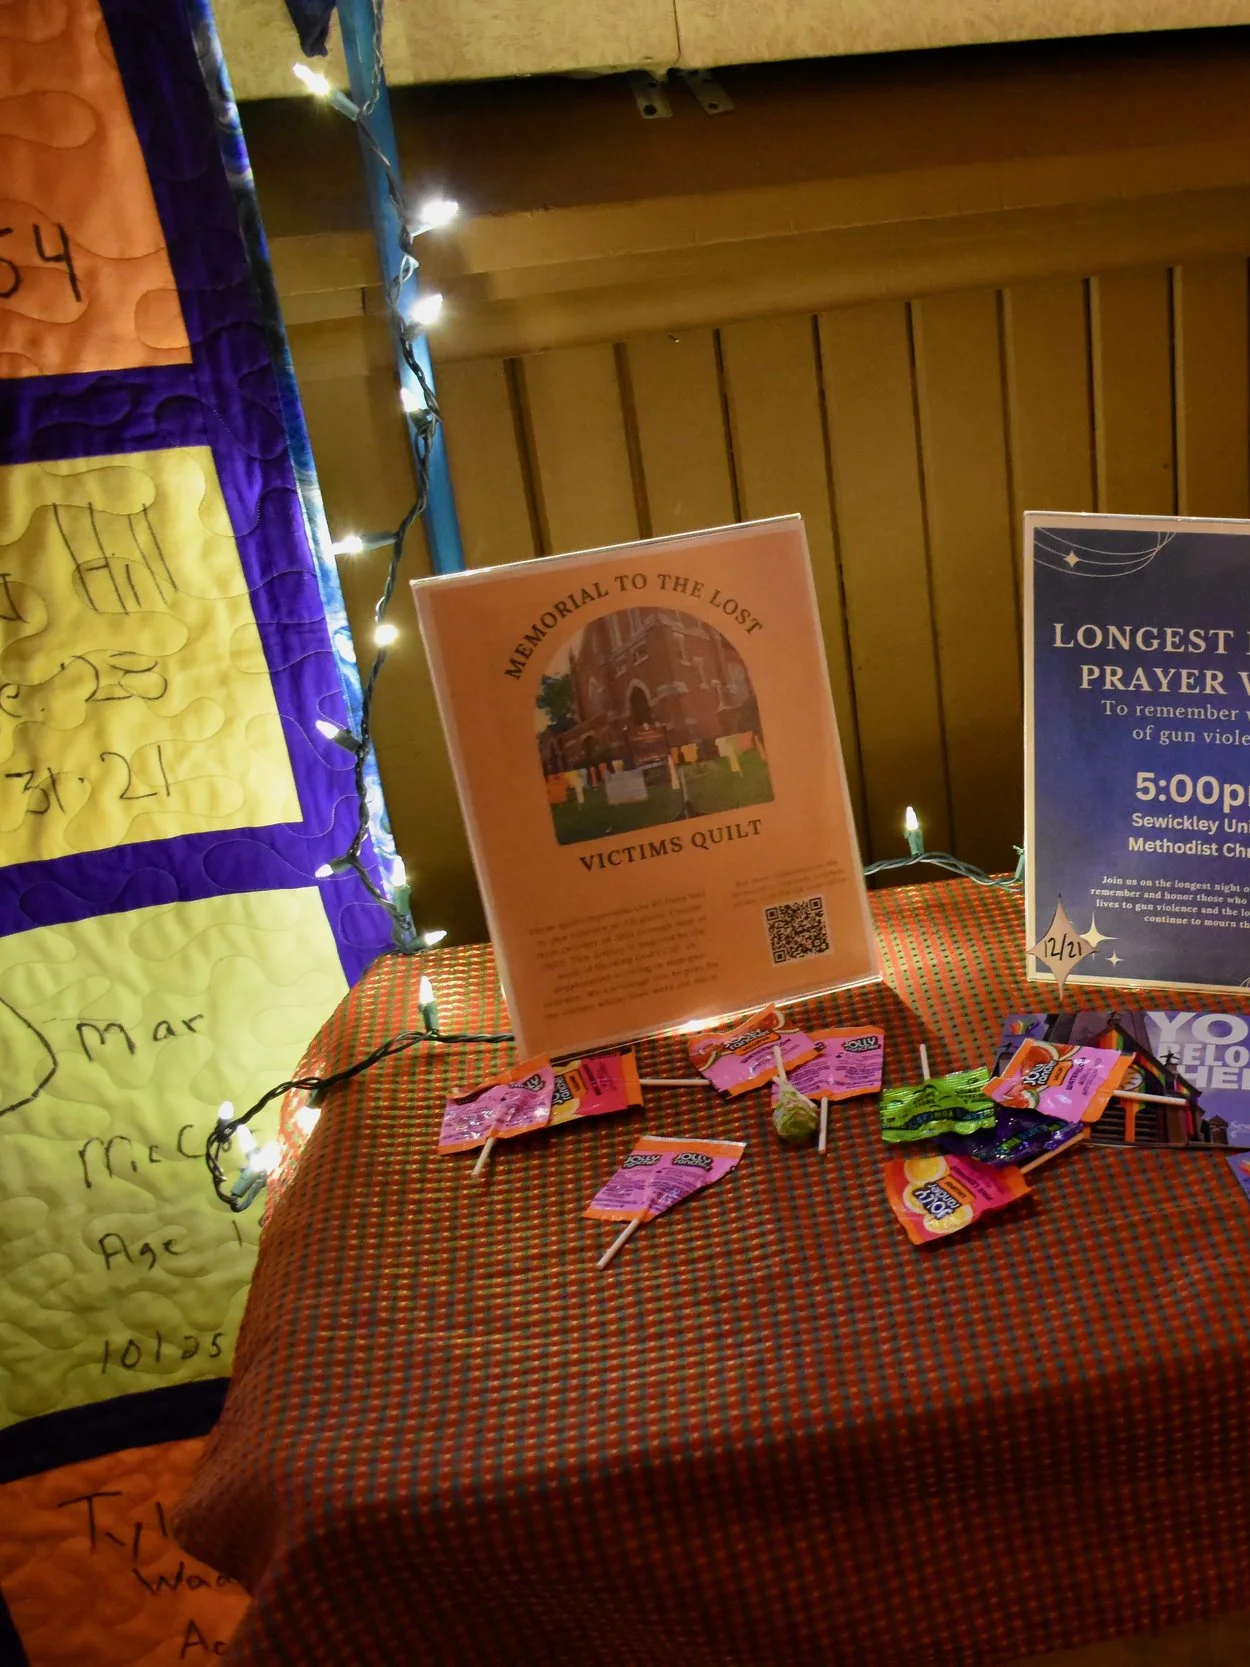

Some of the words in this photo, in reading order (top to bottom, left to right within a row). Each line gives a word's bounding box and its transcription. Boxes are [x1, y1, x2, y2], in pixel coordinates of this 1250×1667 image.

[503, 578, 609, 681] MEMORIAL
[614, 572, 649, 593] TO
[657, 573, 705, 599] THE
[708, 588, 764, 637] LOST
[1053, 622, 1234, 655] LONGEST
[1079, 665, 1228, 696] PRAYER
[1101, 700, 1128, 717] To
[1136, 702, 1239, 722] remember
[1132, 725, 1155, 743] of
[1158, 730, 1196, 747] gun
[1131, 813, 1219, 836] Sewickley
[580, 836, 683, 873] VICTIMS
[691, 818, 764, 851] QUILT
[1128, 837, 1218, 857] Methodist
[1102, 875, 1123, 885] Join
[1125, 878, 1138, 886] us
[1140, 879, 1153, 887] on
[1155, 878, 1172, 888] the
[1174, 879, 1211, 891] longest
[1214, 882, 1240, 893] night
[1090, 888, 1141, 898] remember
[1143, 890, 1162, 899] and
[1164, 891, 1194, 901] honor
[1196, 893, 1224, 903] those
[1226, 896, 1247, 905] who
[1096, 899, 1120, 908] lives
[1122, 901, 1133, 909] to
[1135, 903, 1154, 912] gun
[1157, 902, 1198, 913] violence
[1201, 906, 1219, 915] and
[1221, 907, 1238, 916] the
[1144, 915, 1188, 925] continue
[1191, 917, 1201, 925] to
[1204, 919, 1236, 927] mourn
[1044, 933, 1082, 960] 12/21
[843, 1036, 877, 1049] JOLLY
[676, 1153, 712, 1164] JOLLY
[914, 1188, 954, 1220] JOLLY
[927, 1182, 960, 1210] rancher
